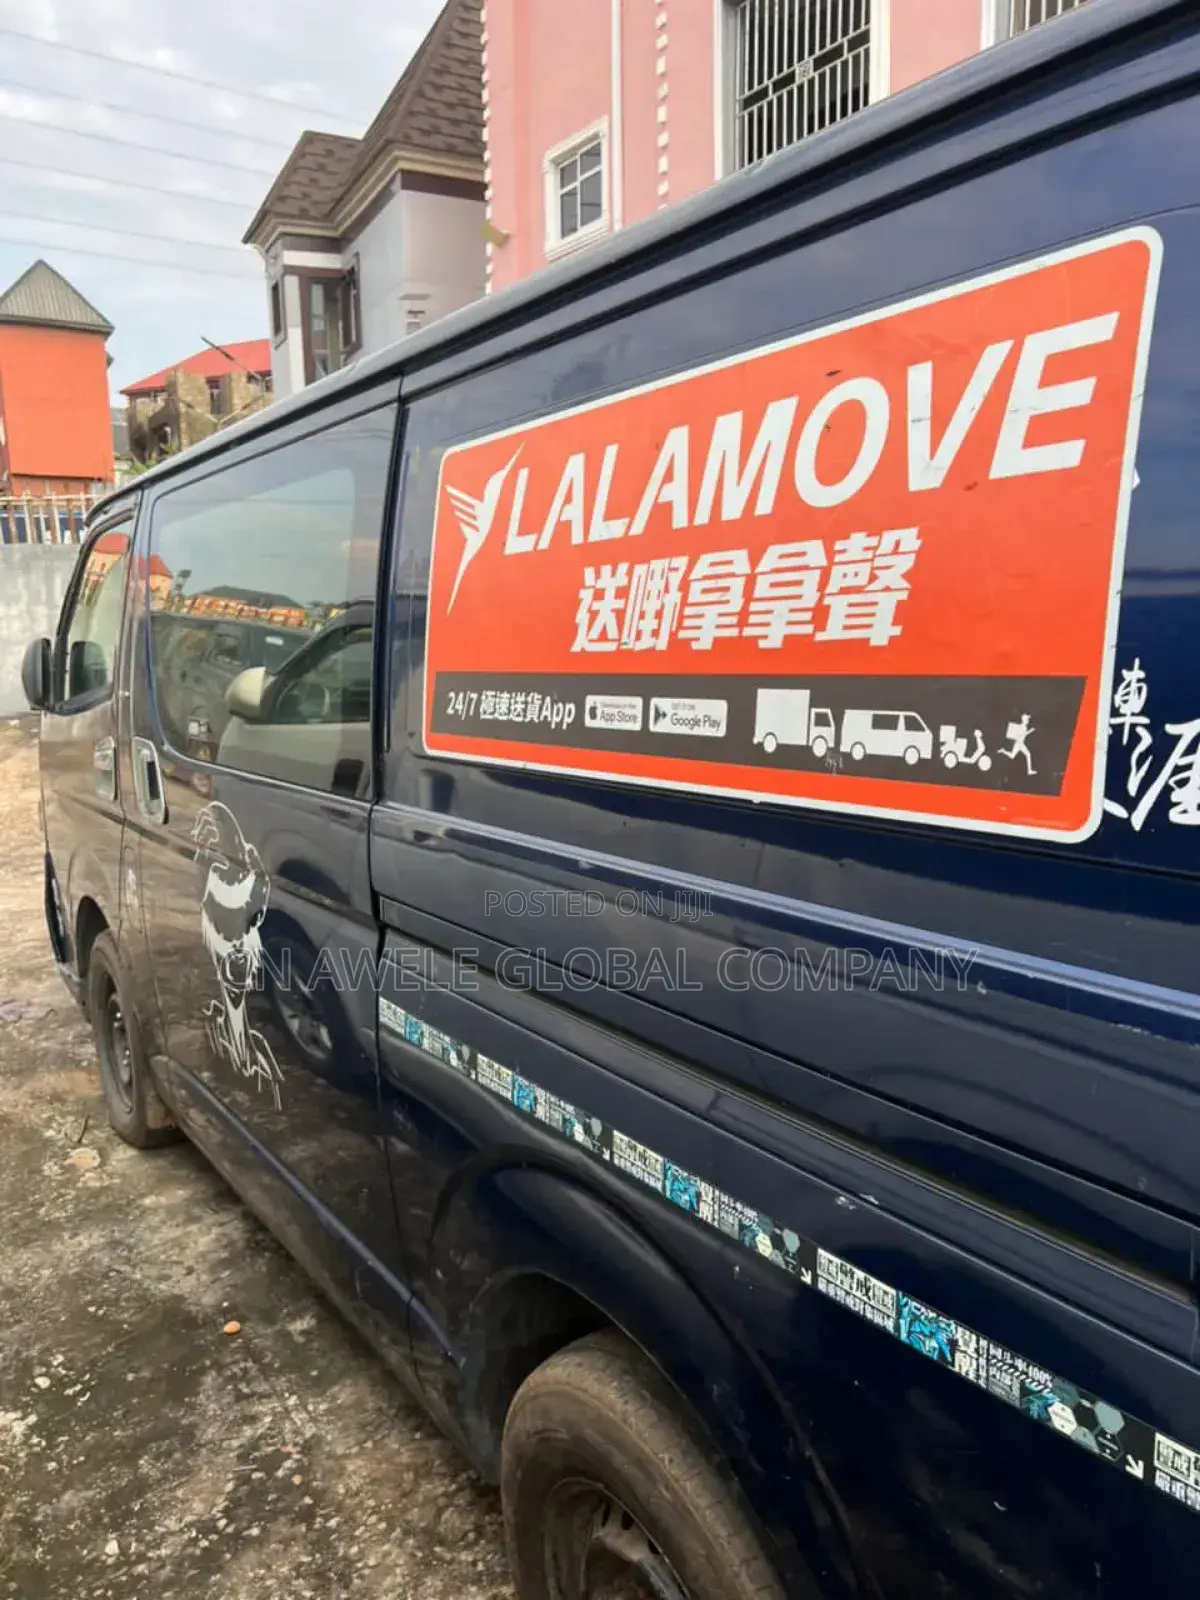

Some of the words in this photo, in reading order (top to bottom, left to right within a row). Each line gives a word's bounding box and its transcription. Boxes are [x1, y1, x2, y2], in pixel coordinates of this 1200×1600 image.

[503, 310, 1120, 556] LALAMOVE
[570, 526, 923, 652] 送嘢拿拿聲
[446, 691, 477, 721] 24/7
[599, 710, 617, 724] App
[617, 711, 638, 726] Store
[670, 713, 702, 731] Google
[703, 714, 721, 732] Play
